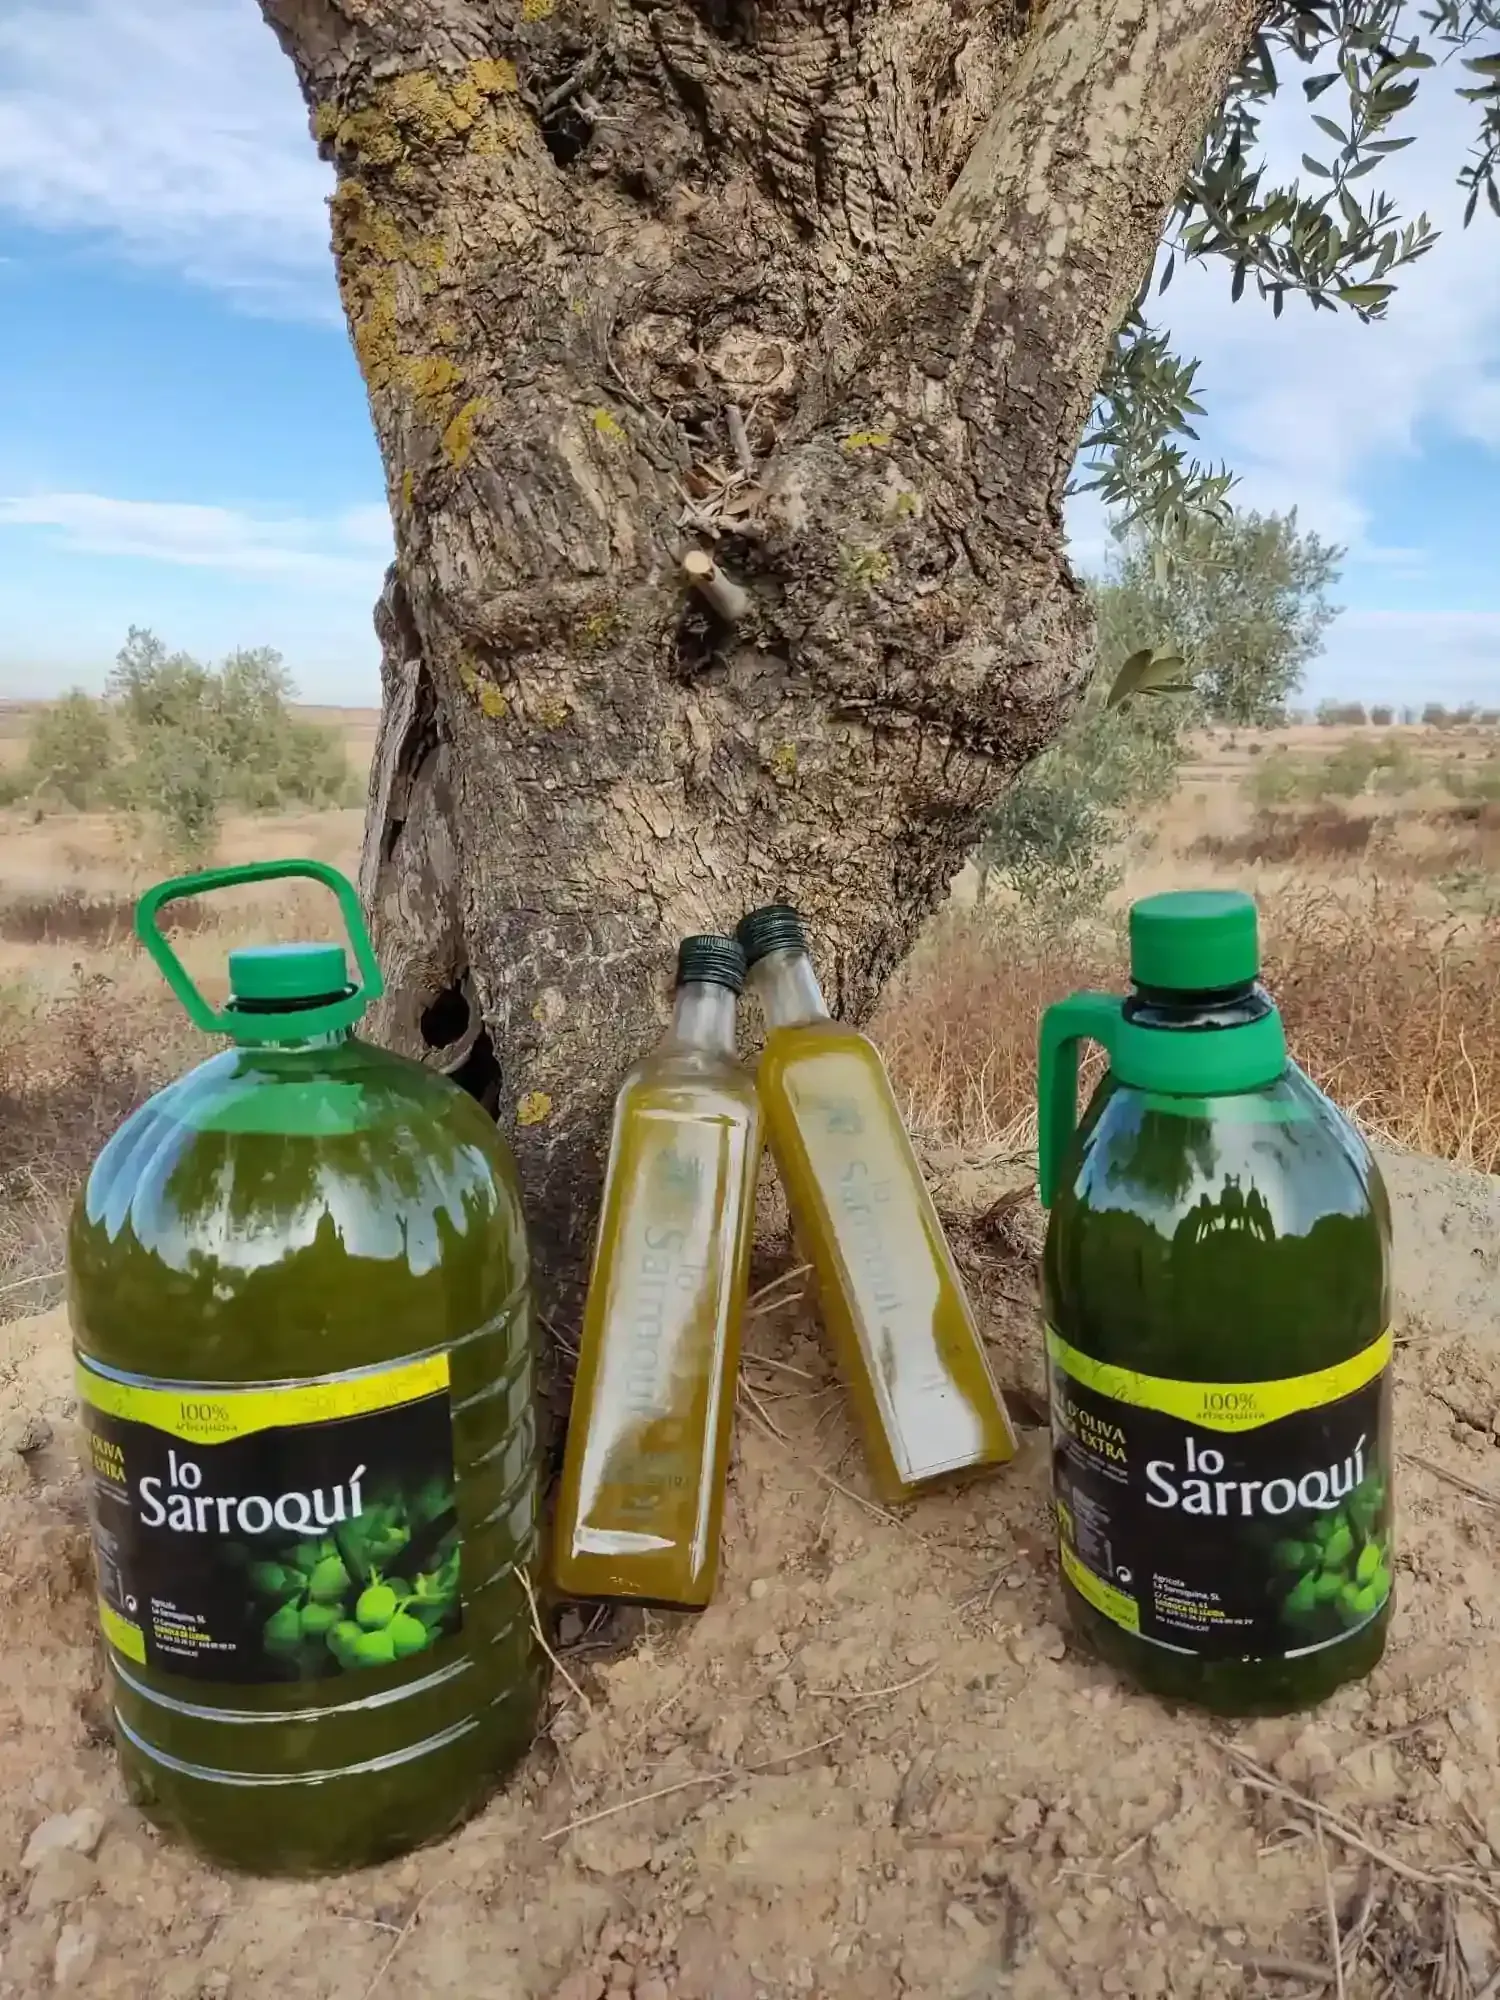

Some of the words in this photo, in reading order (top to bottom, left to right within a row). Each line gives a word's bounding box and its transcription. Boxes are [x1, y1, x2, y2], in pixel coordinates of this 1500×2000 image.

[180, 1400, 229, 1421] 100%
[1203, 1391, 1257, 1411] 100%
[1080, 1427, 1129, 1464] EXTRA
[1185, 1436, 1225, 1475] lo
[167, 1449, 201, 1490] lo
